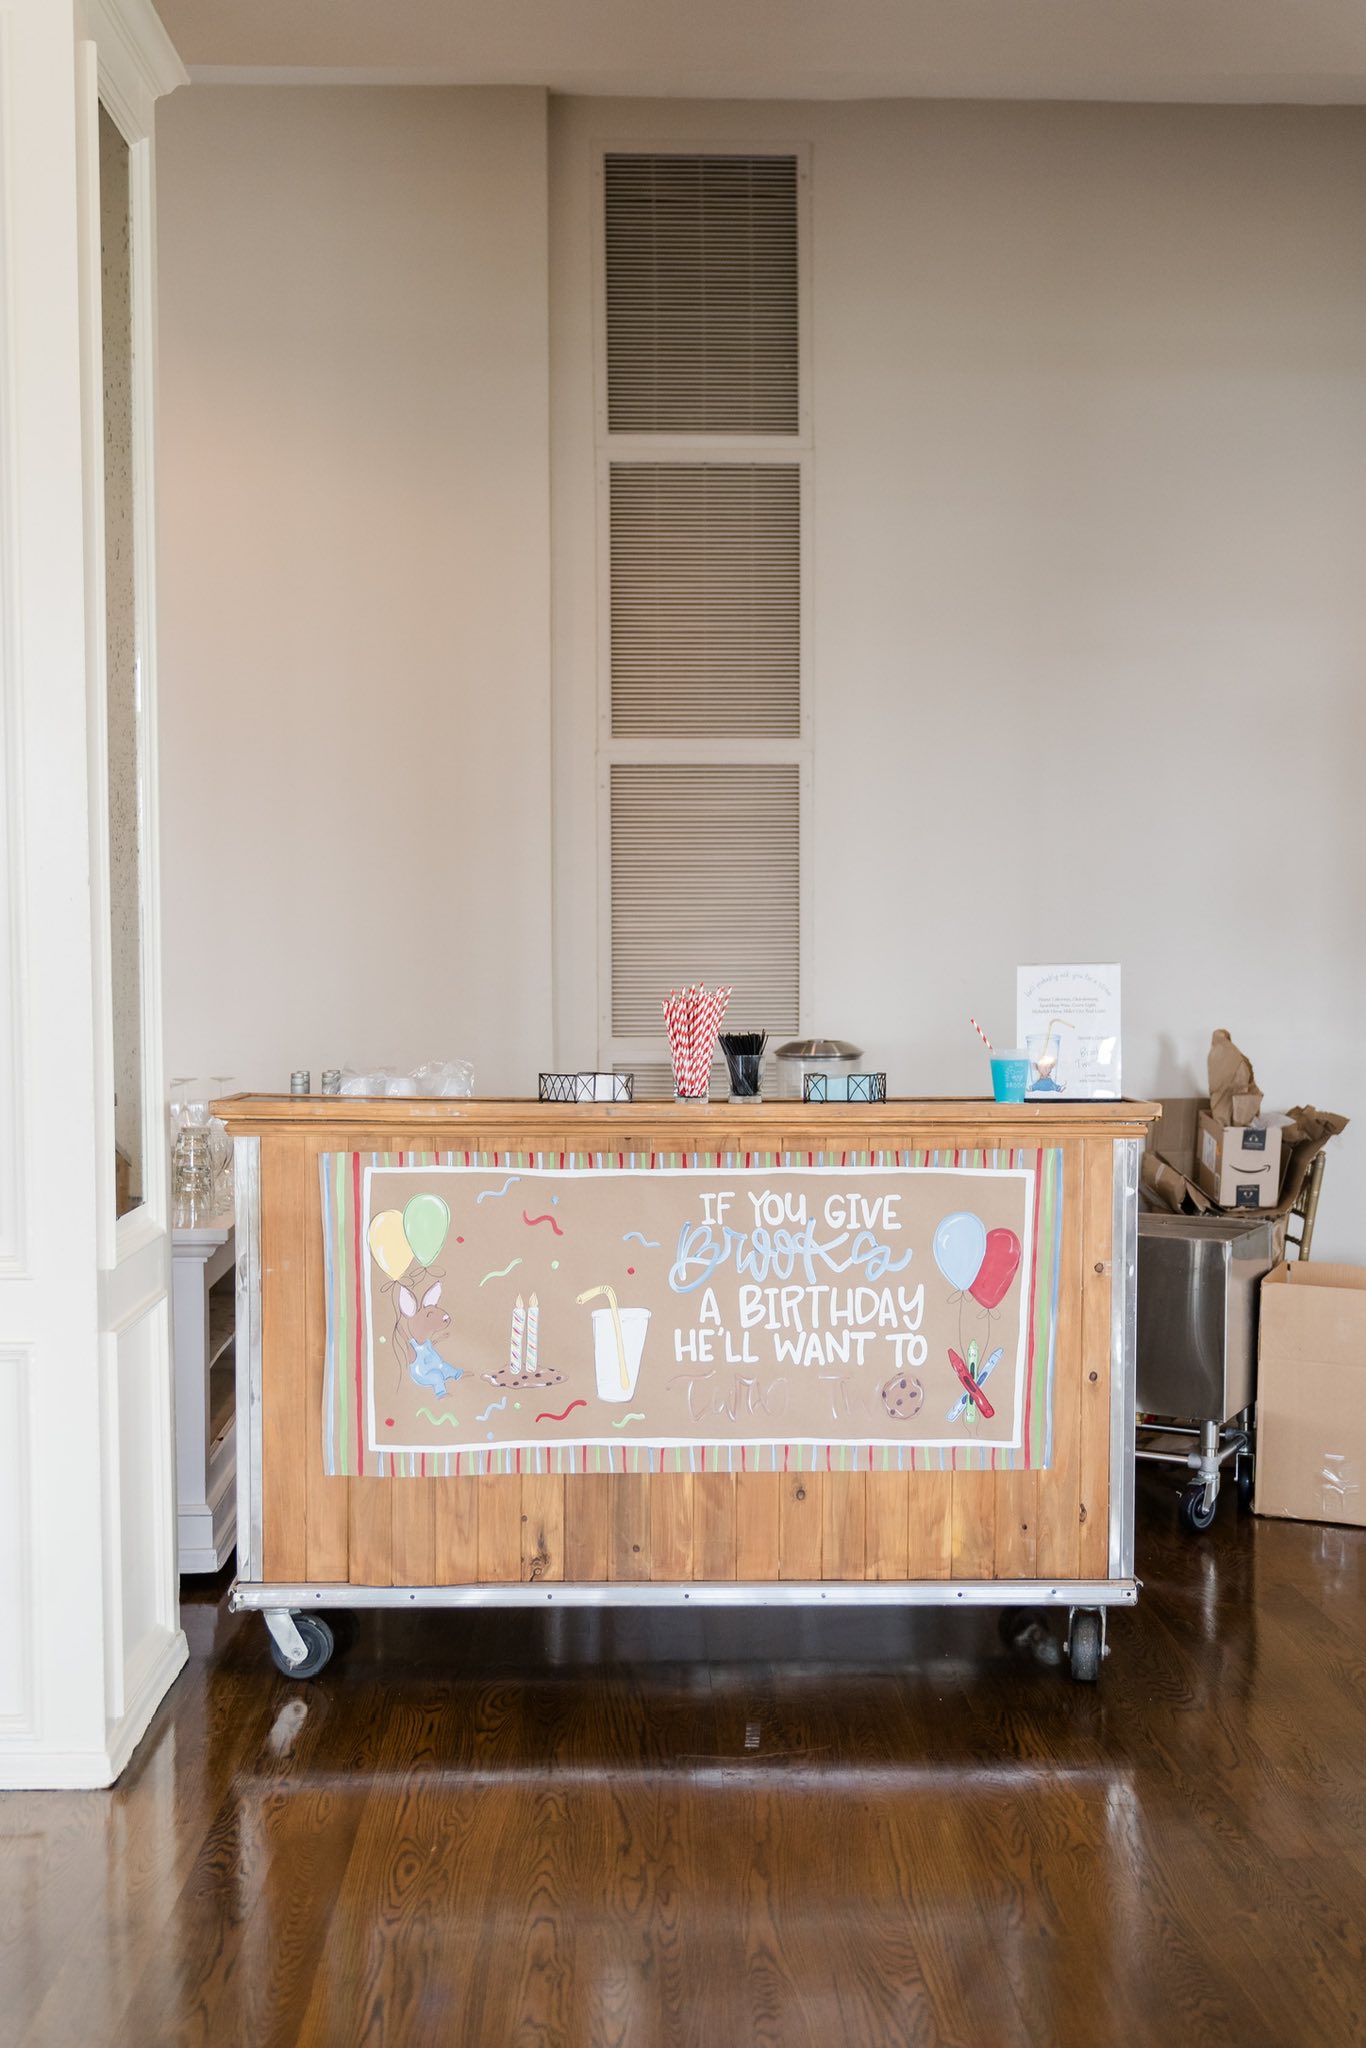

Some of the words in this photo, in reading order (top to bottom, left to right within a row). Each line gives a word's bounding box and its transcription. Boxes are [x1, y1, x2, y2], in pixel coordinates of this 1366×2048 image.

[699, 1191, 735, 1225] IF
[748, 1190, 806, 1227] YOU
[824, 1193, 902, 1230] GIVE
[699, 1287, 721, 1326] A
[739, 1284, 925, 1332] BIRTHDAY
[674, 1326, 759, 1363] HE'LL
[774, 1329, 877, 1366] WANT
[885, 1333, 928, 1368] TO
